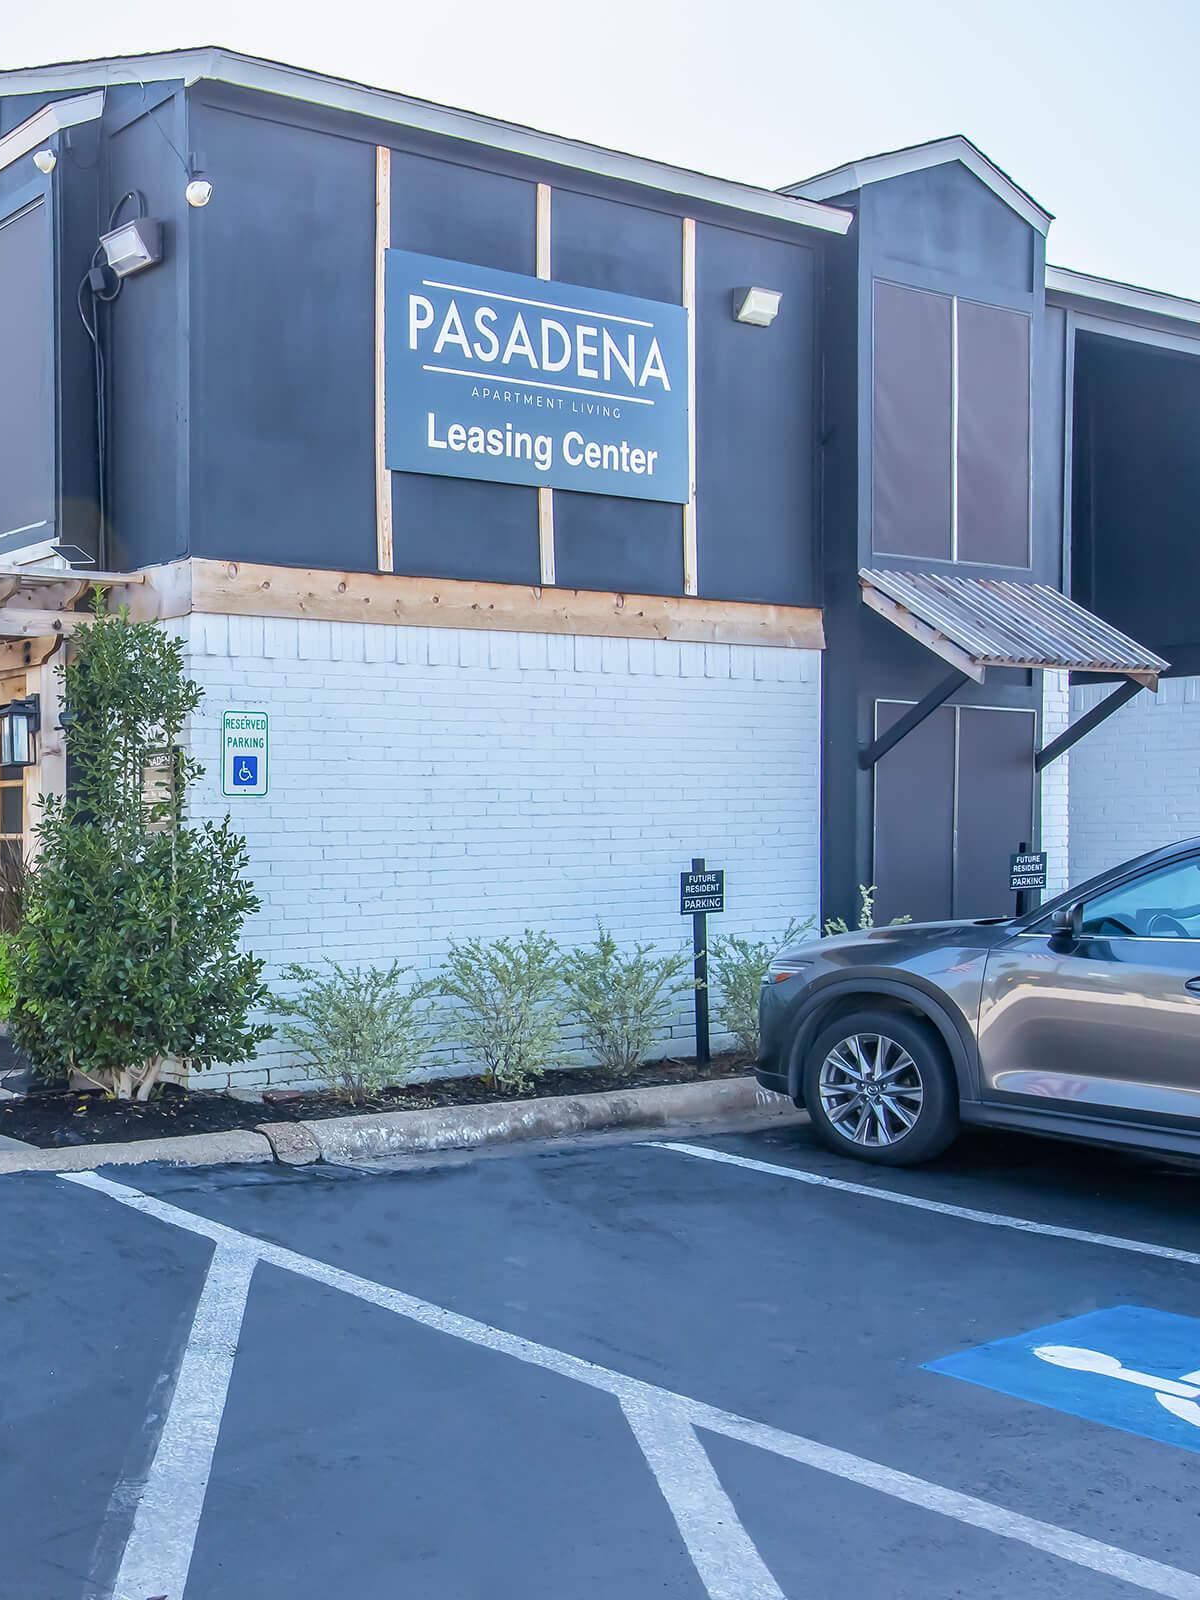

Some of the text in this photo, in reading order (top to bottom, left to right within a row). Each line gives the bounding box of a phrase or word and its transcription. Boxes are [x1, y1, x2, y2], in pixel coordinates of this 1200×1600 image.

[408, 294, 672, 391] PASADENA
[471, 386, 622, 419] APARTMENT LIVING
[426, 412, 658, 475] Leasing Center
[225, 718, 266, 730] RESERVED
[227, 736, 264, 748] PARKING
[1016, 854, 1041, 864] FUTURE
[1013, 863, 1043, 872] RESIDENT
[689, 873, 717, 883] FUTURE
[1012, 876, 1044, 887] PARKING
[685, 883, 720, 894] RESIDENT
[684, 897, 721, 910] PARKING
